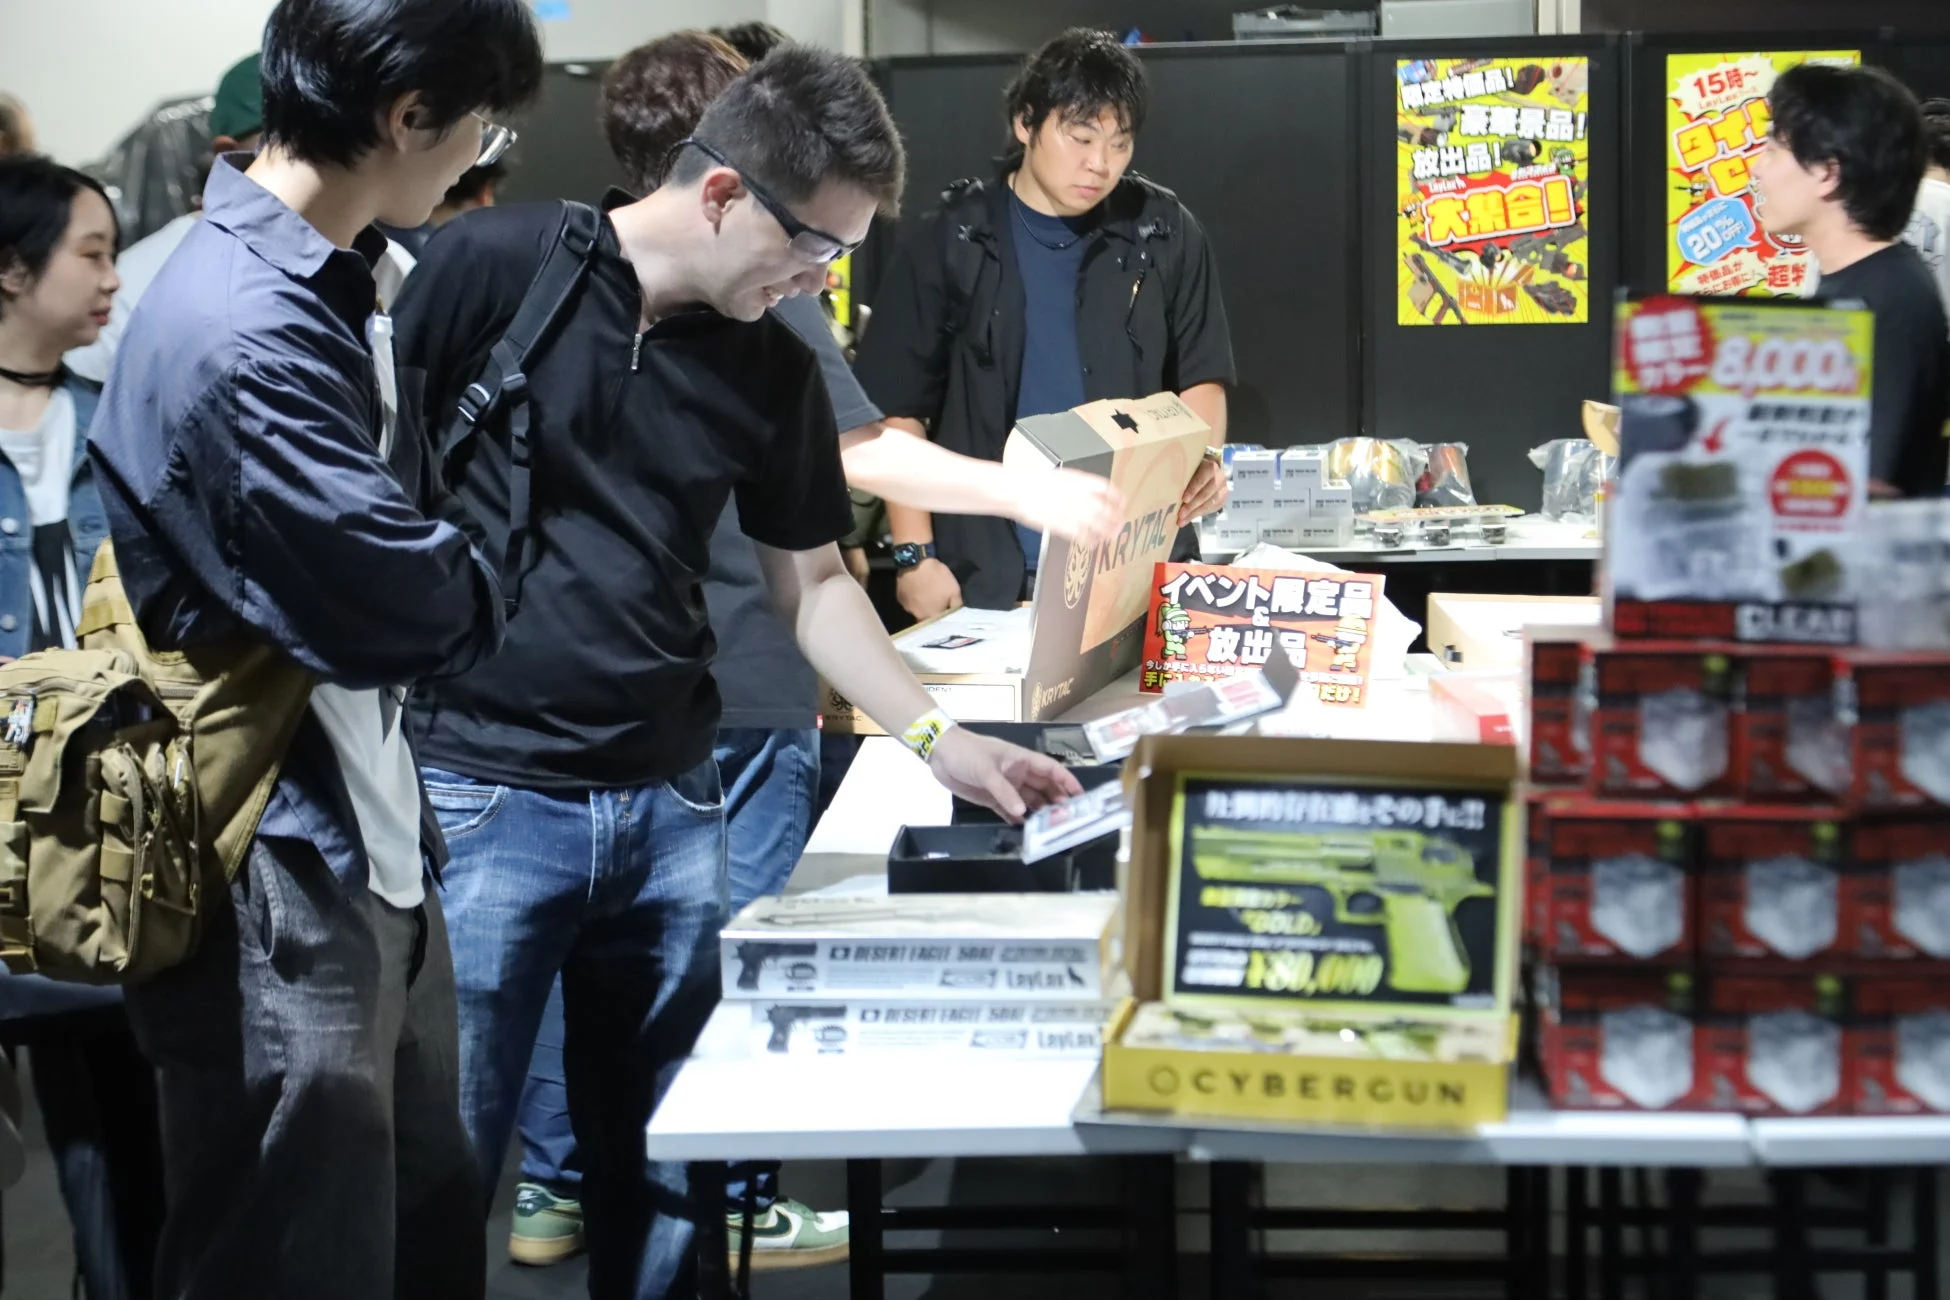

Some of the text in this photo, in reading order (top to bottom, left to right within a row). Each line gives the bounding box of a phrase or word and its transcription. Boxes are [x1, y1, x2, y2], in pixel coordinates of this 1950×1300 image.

[1411, 141, 1502, 180] 放出品!
[1427, 178, 1573, 242] 大集合!
[1160, 571, 1374, 620] イベント限定品
[1251, 605, 1271, 628] &
[1205, 626, 1308, 670] 放出品
[1041, 677, 1075, 708] KRYTAC
[1191, 1068, 1468, 1107] CYBERGUN
